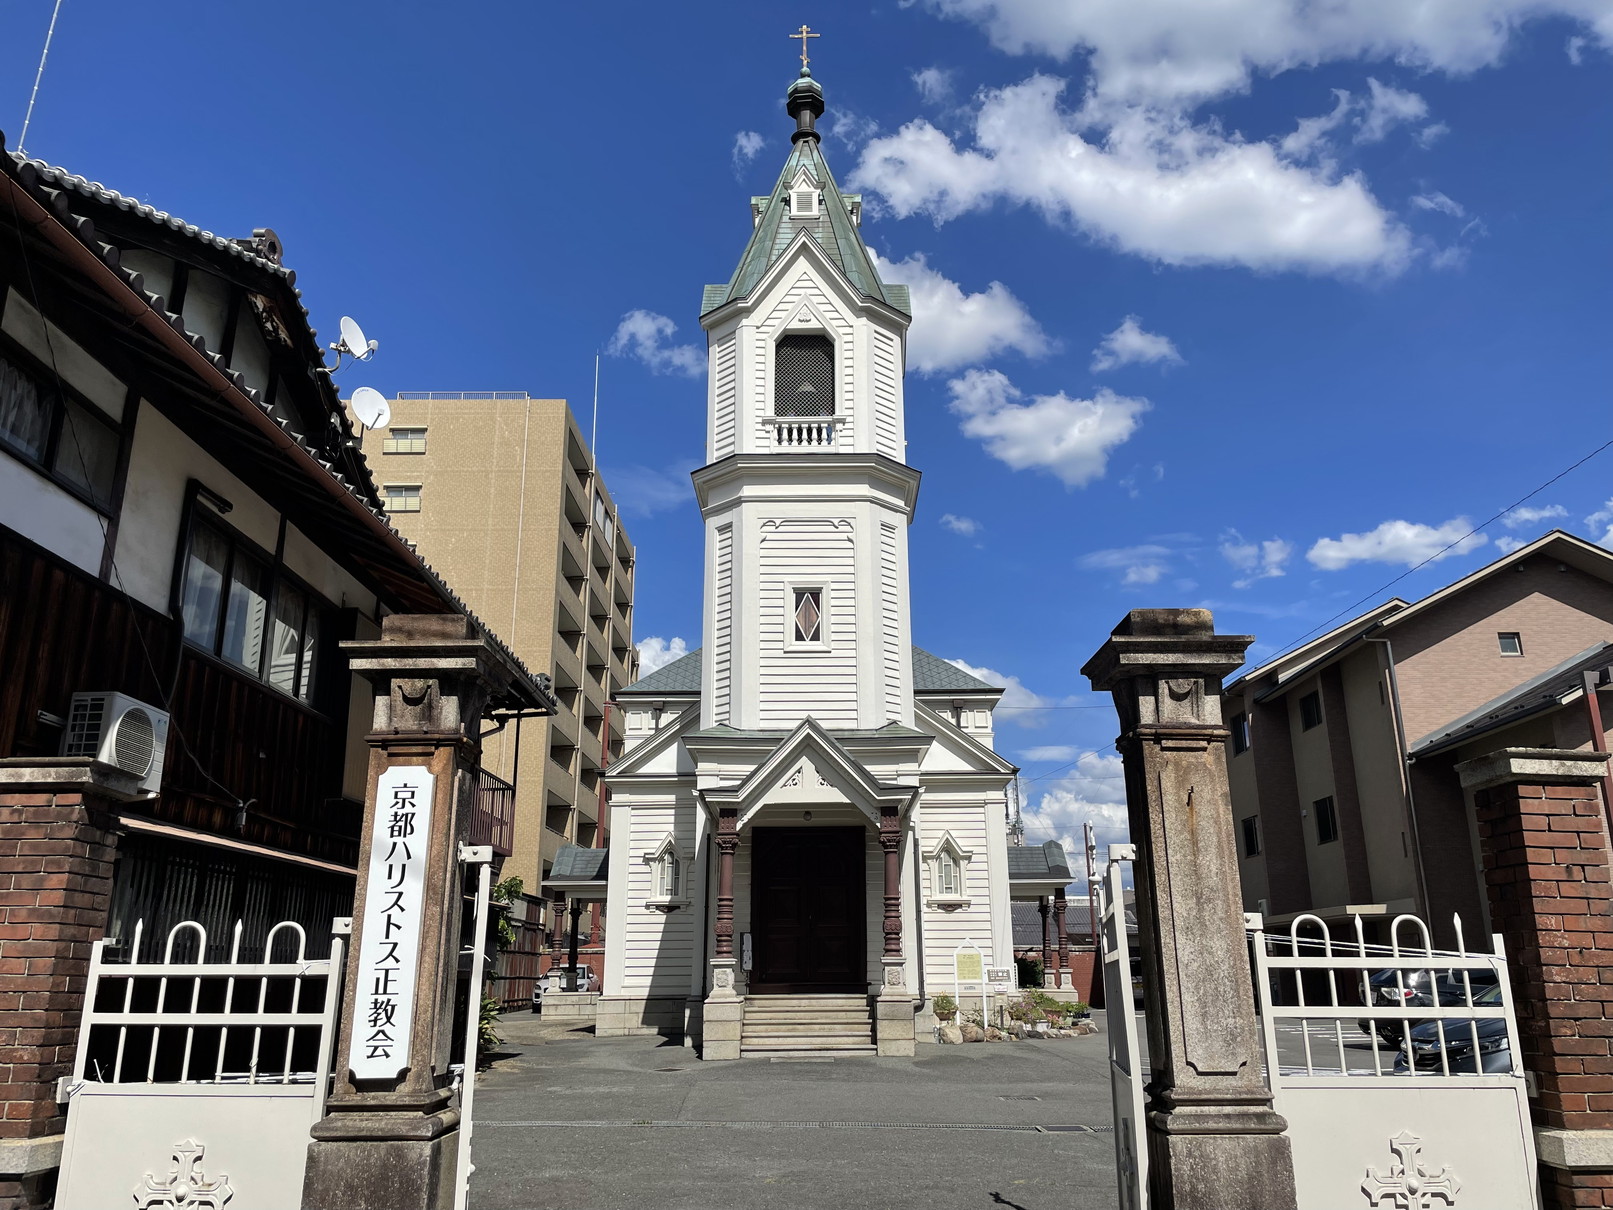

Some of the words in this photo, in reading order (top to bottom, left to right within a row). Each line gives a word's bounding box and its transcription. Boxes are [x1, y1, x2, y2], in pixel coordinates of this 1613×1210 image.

[366, 783, 419, 1059] 京都ハリストス正教会
